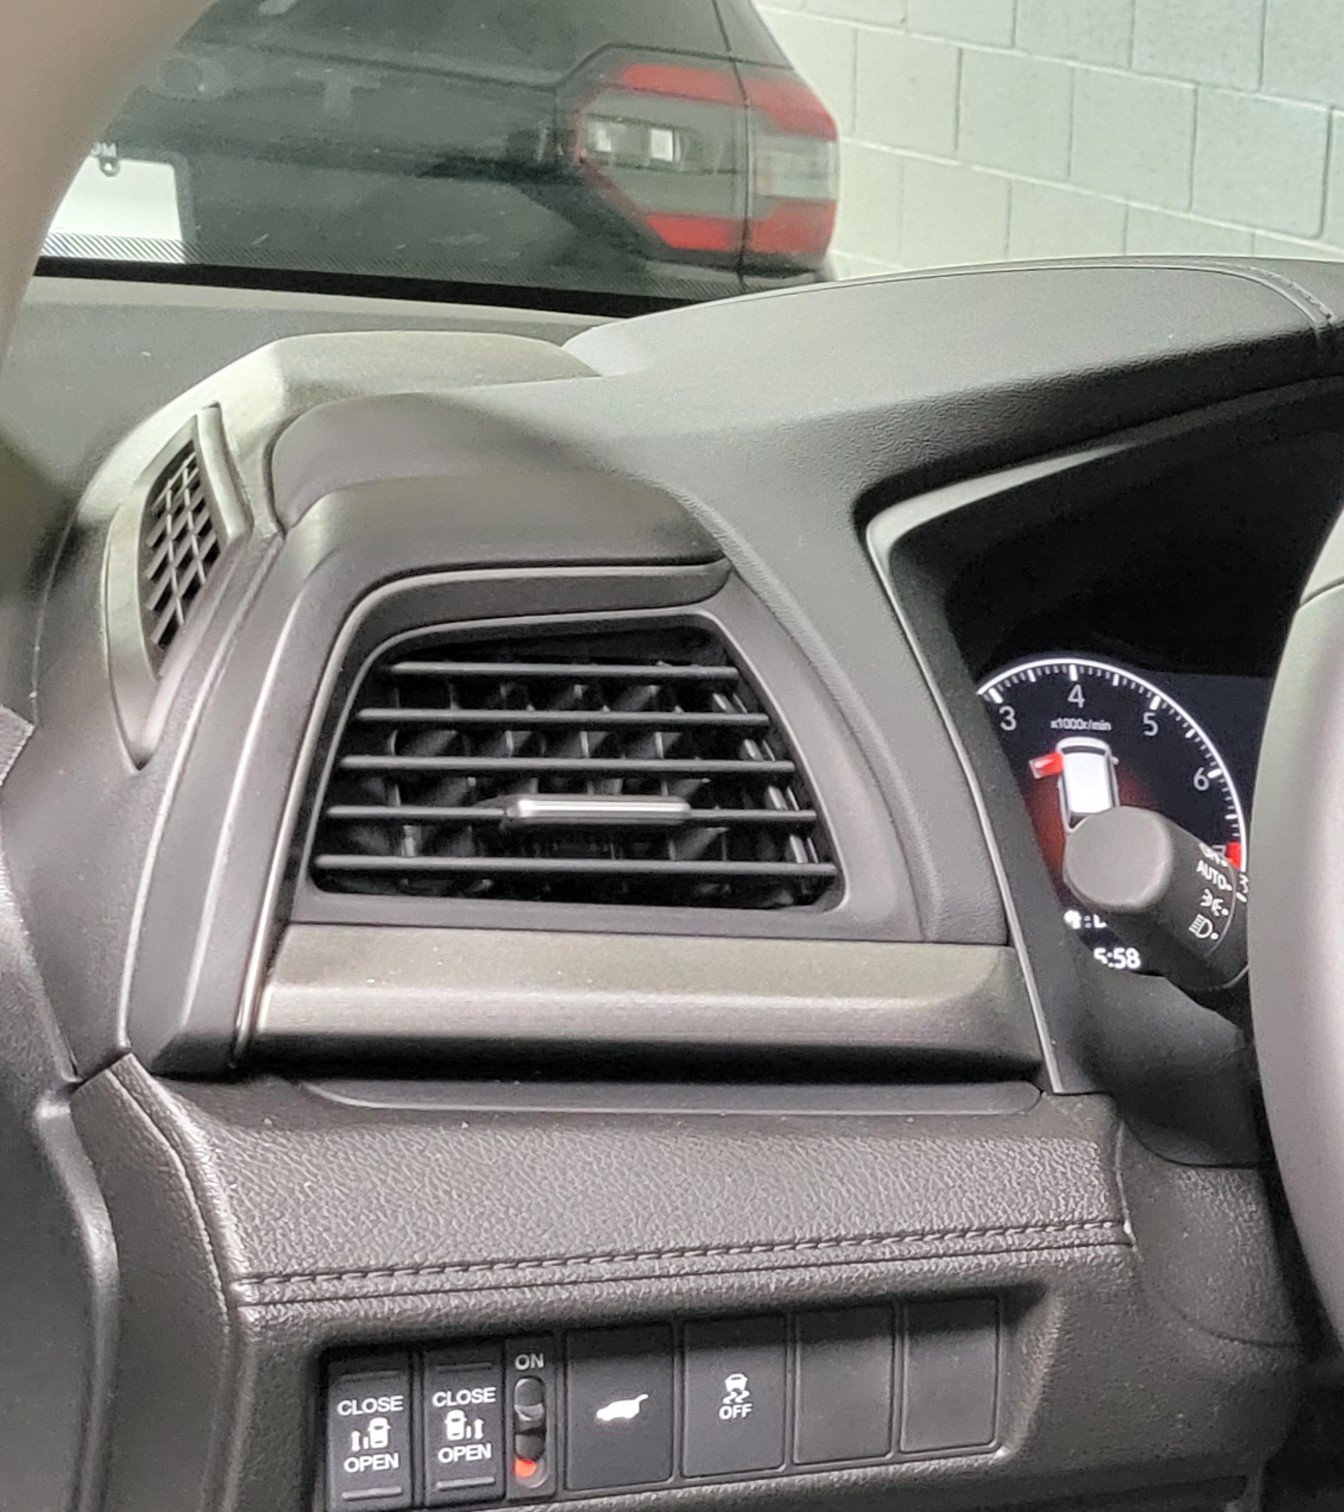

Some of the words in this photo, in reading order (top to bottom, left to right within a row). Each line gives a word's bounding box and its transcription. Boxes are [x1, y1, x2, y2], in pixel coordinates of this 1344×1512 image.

[1067, 685, 1085, 708] 4
[1000, 706, 1017, 730] 3
[1143, 712, 1159, 736] 5
[1193, 768, 1210, 790] 6
[1196, 859, 1227, 890] AUTO
[1093, 947, 1141, 969] 5:58
[514, 1352, 545, 1371] ON
[337, 1395, 404, 1416] CLOSE
[432, 1386, 496, 1407] CLOSE
[718, 1402, 753, 1421] OFF
[343, 1452, 400, 1473] OPEN
[437, 1442, 493, 1464] OPEN
